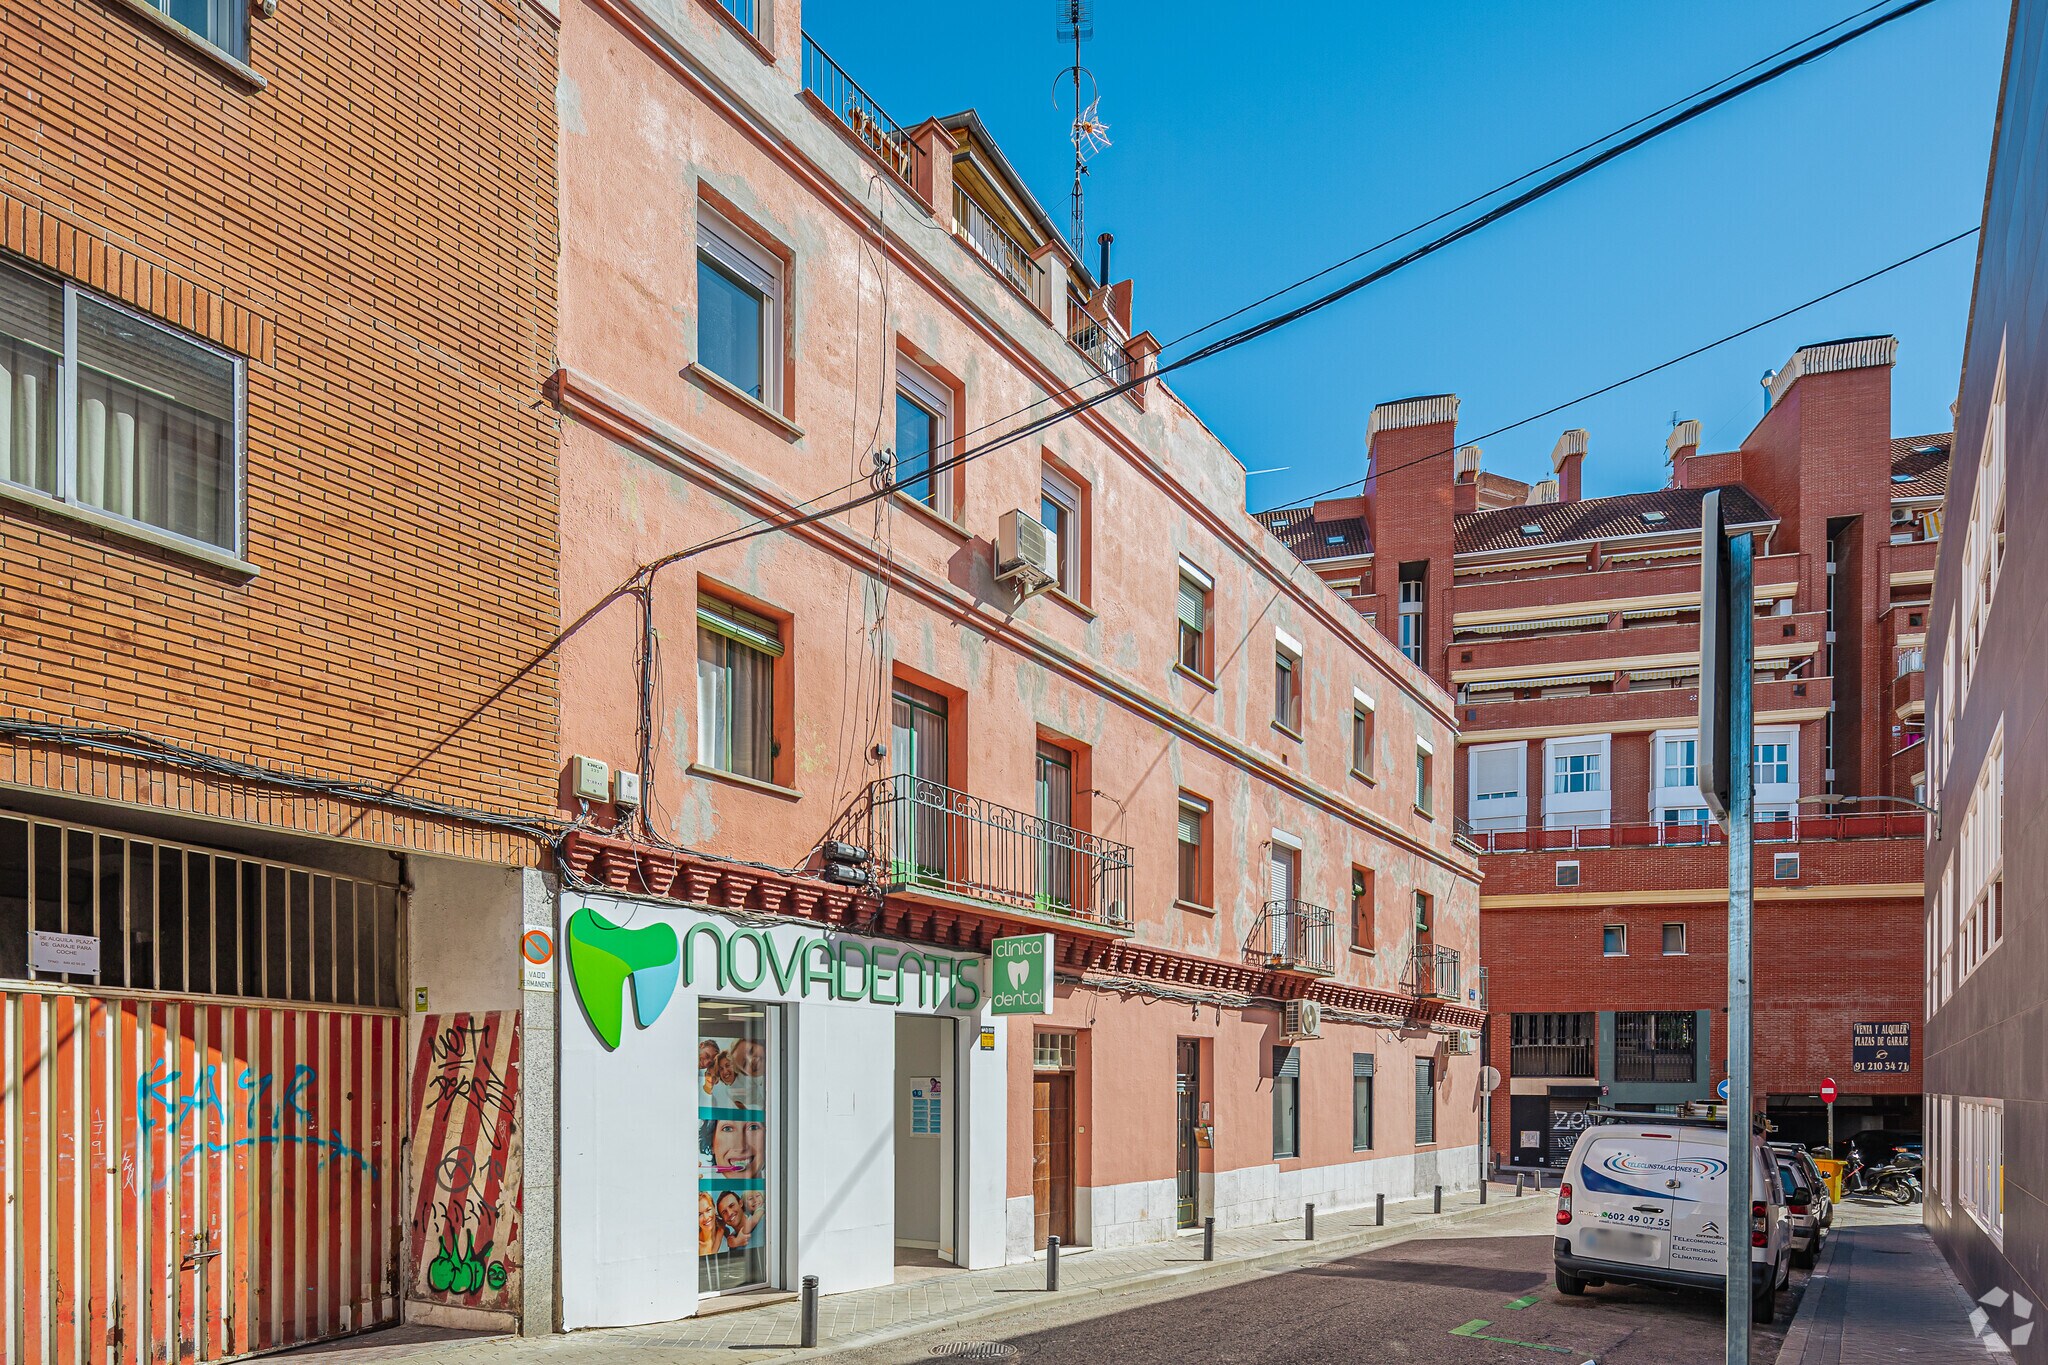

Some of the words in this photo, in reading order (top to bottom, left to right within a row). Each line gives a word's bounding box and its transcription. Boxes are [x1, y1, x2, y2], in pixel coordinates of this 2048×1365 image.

[683, 921, 981, 1010] NOVADENTIS
[529, 971, 546, 979] VADO
[994, 989, 1043, 1007] dental
[1856, 1024, 1873, 1035] VENTA
[1875, 1024, 1879, 1034] Y
[1881, 1024, 1907, 1036] ALQUILER
[1854, 1036, 1875, 1046] PLAZAS
[1877, 1036, 1885, 1046] DE
[1886, 1036, 1909, 1046] GARAJE
[1855, 1061, 1865, 1071] 91
[1867, 1061, 1883, 1071] 210
[1884, 1061, 1896, 1071] 34
[1897, 1061, 1908, 1071] 71
[1607, 1211, 1625, 1221] 602
[1627, 1214, 1640, 1223] 49
[1642, 1216, 1655, 1225] 07
[1657, 1218, 1670, 1227] 55
[1672, 1245, 1716, 1254] ELECTRICIDAD
[1671, 1253, 1718, 1263] CLIMATIZACIÓN
